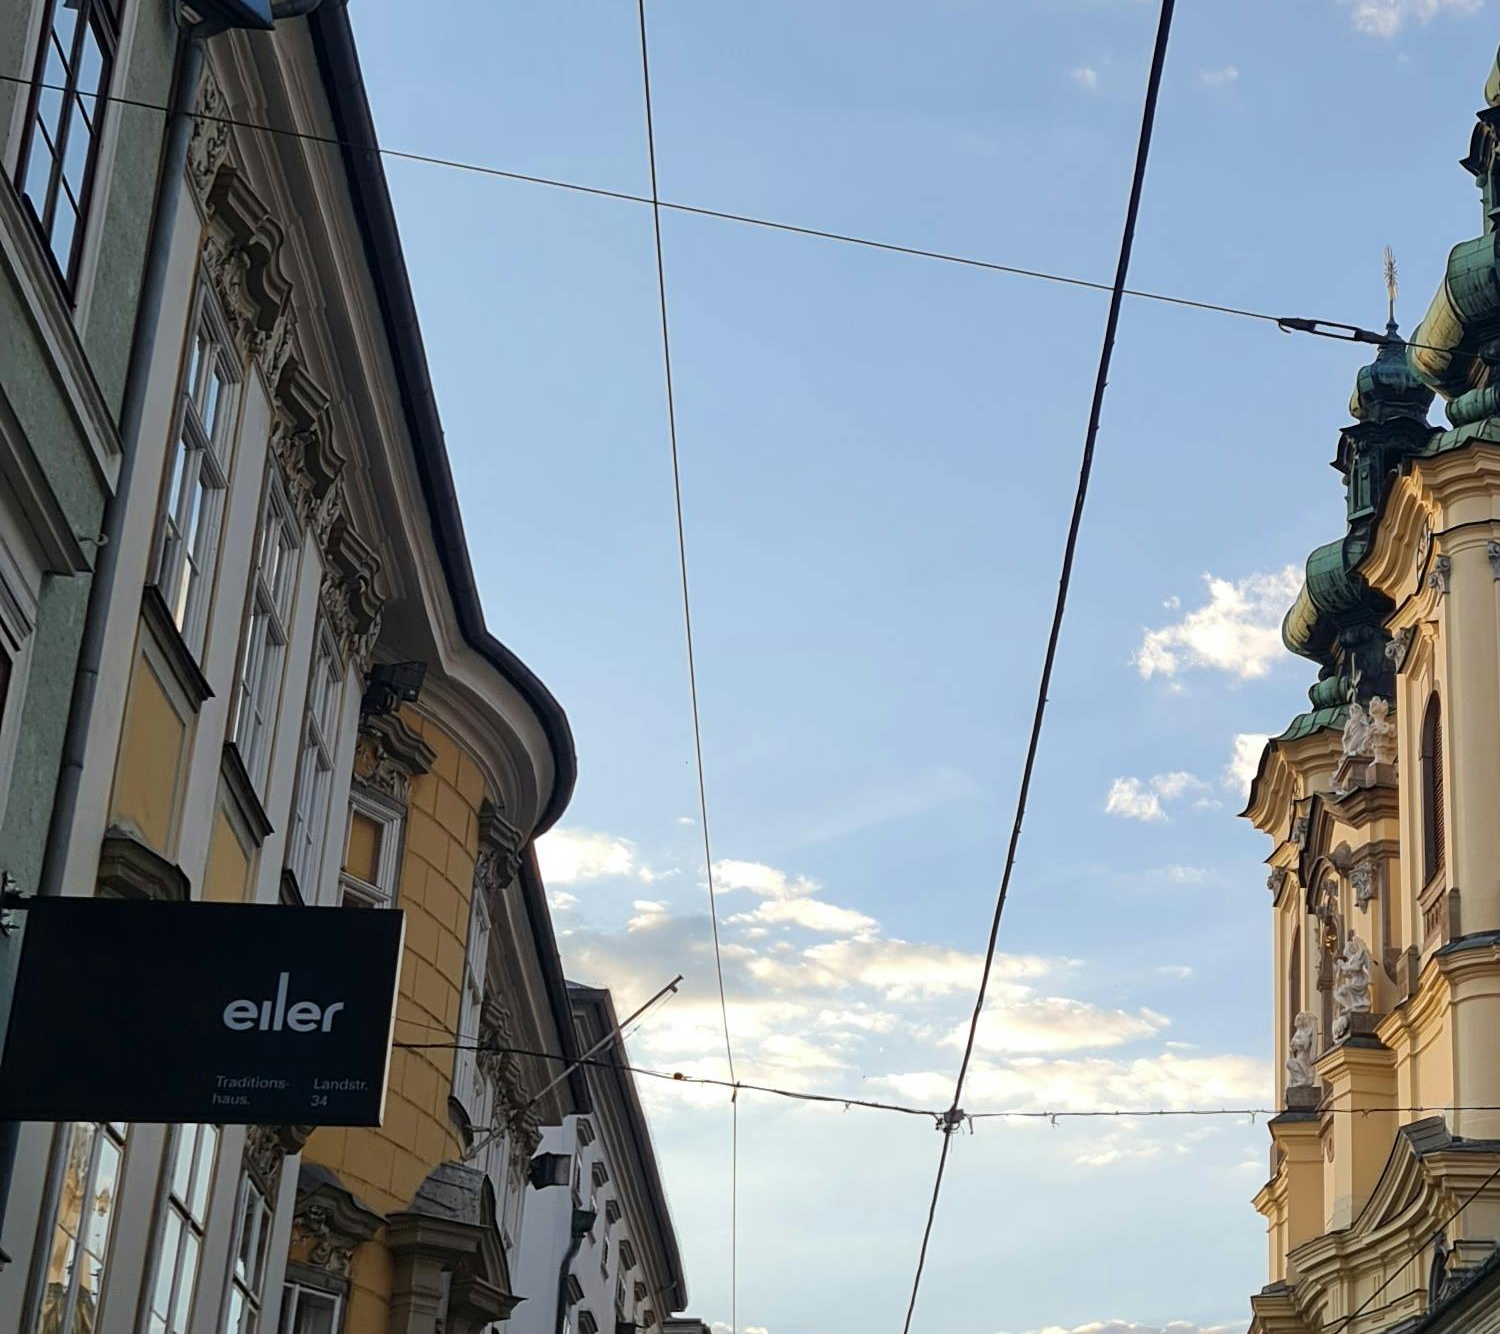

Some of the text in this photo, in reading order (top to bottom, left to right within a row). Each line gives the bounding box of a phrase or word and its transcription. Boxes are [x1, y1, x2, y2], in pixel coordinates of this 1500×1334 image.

[222, 971, 345, 1033] eiler
[215, 1074, 291, 1090] Traditions-
[312, 1077, 369, 1092] Landstr.
[211, 1092, 251, 1107] haus.
[309, 1094, 329, 1108] 34
